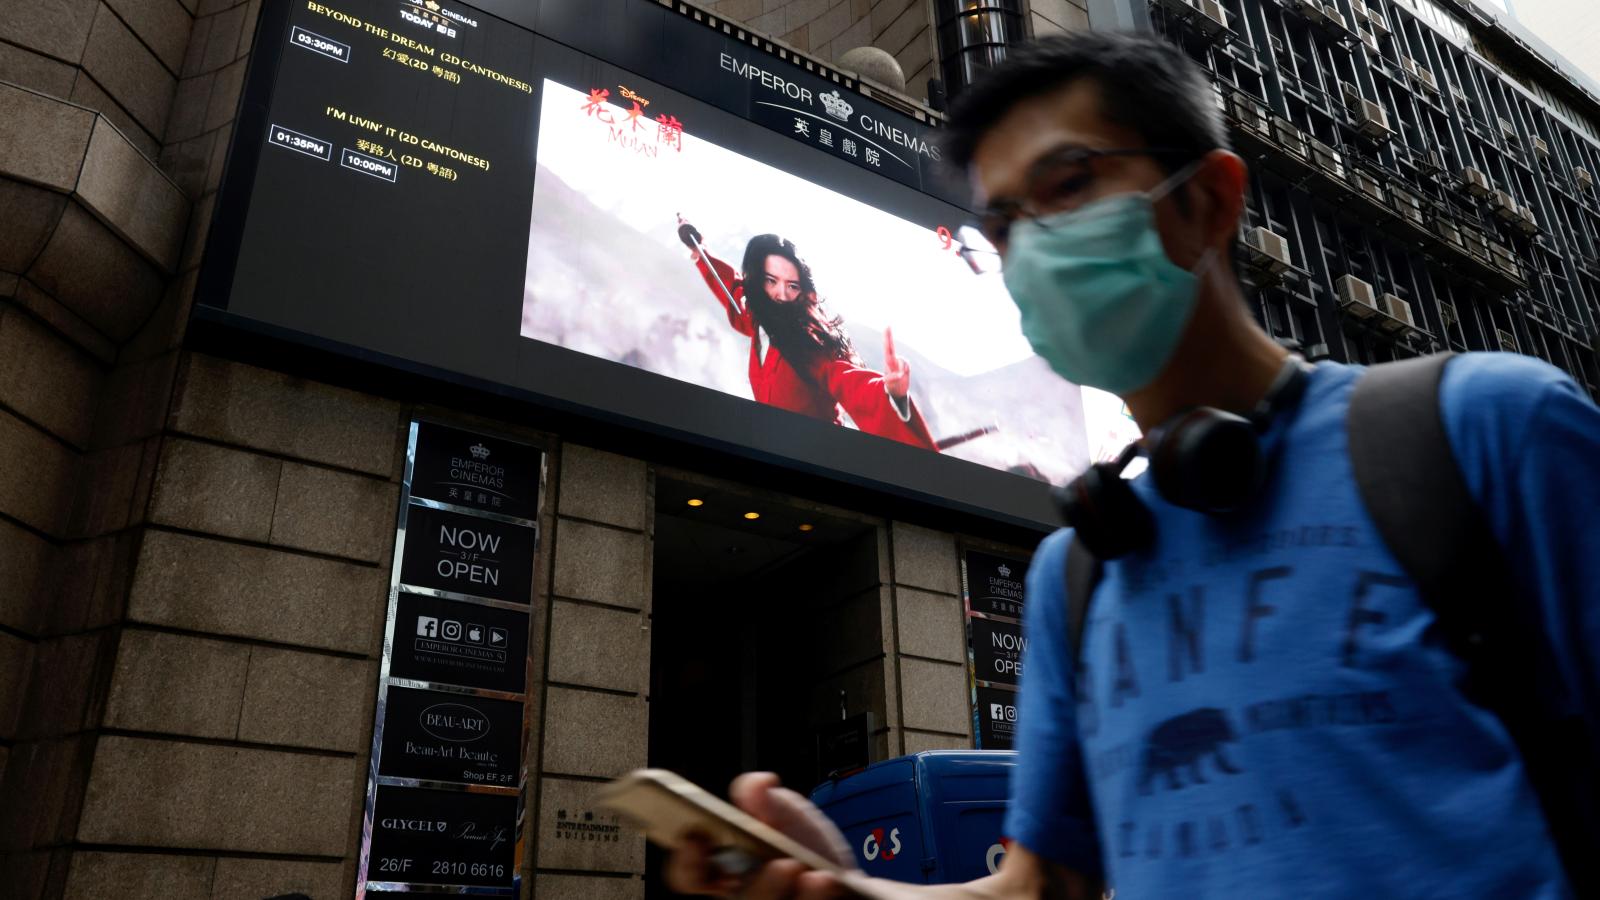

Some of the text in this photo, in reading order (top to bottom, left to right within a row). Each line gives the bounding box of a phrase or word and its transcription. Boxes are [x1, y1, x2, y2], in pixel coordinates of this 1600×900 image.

[400, 10, 434, 29] TODAY
[441, 8, 478, 28] CINEMAS
[298, 33, 343, 56] 03:30PM
[307, 1, 533, 94] BEYOND THE DREAM (2D CANTONESE)
[618, 85, 650, 108] Disney
[720, 52, 942, 162] EMPEROR CINEMAS
[580, 88, 682, 152] 花木蘭
[276, 132, 324, 154] 01:35PM
[385, 127, 397, 137] IT
[399, 131, 419, 145] (2D
[420, 139, 490, 171] CANTONESE)
[794, 117, 881, 167] 英皇戲院
[348, 155, 392, 176] 10:00PM
[400, 154, 423, 168] (2D
[451, 457, 505, 478] EMPEROR
[450, 468, 504, 489] CINEMAS
[439, 524, 501, 554] NOW
[460, 551, 480, 561] 3/F
[437, 559, 499, 586] OPEN
[989, 576, 1022, 590] EMPEROR
[990, 586, 1023, 600] CINEMAS
[991, 631, 1028, 652] NOW
[994, 658, 1026, 676] OPE
[426, 713, 484, 731] BEAU-ART
[405, 740, 453, 758] Beau-Art
[463, 769, 485, 781] Shop
[499, 774, 513, 782] 2/F
[381, 818, 435, 832] GLYCEL
[556, 831, 619, 842] BUILDING
[863, 827, 902, 862] G4S
[379, 857, 505, 878] 26/F 2810 6616
